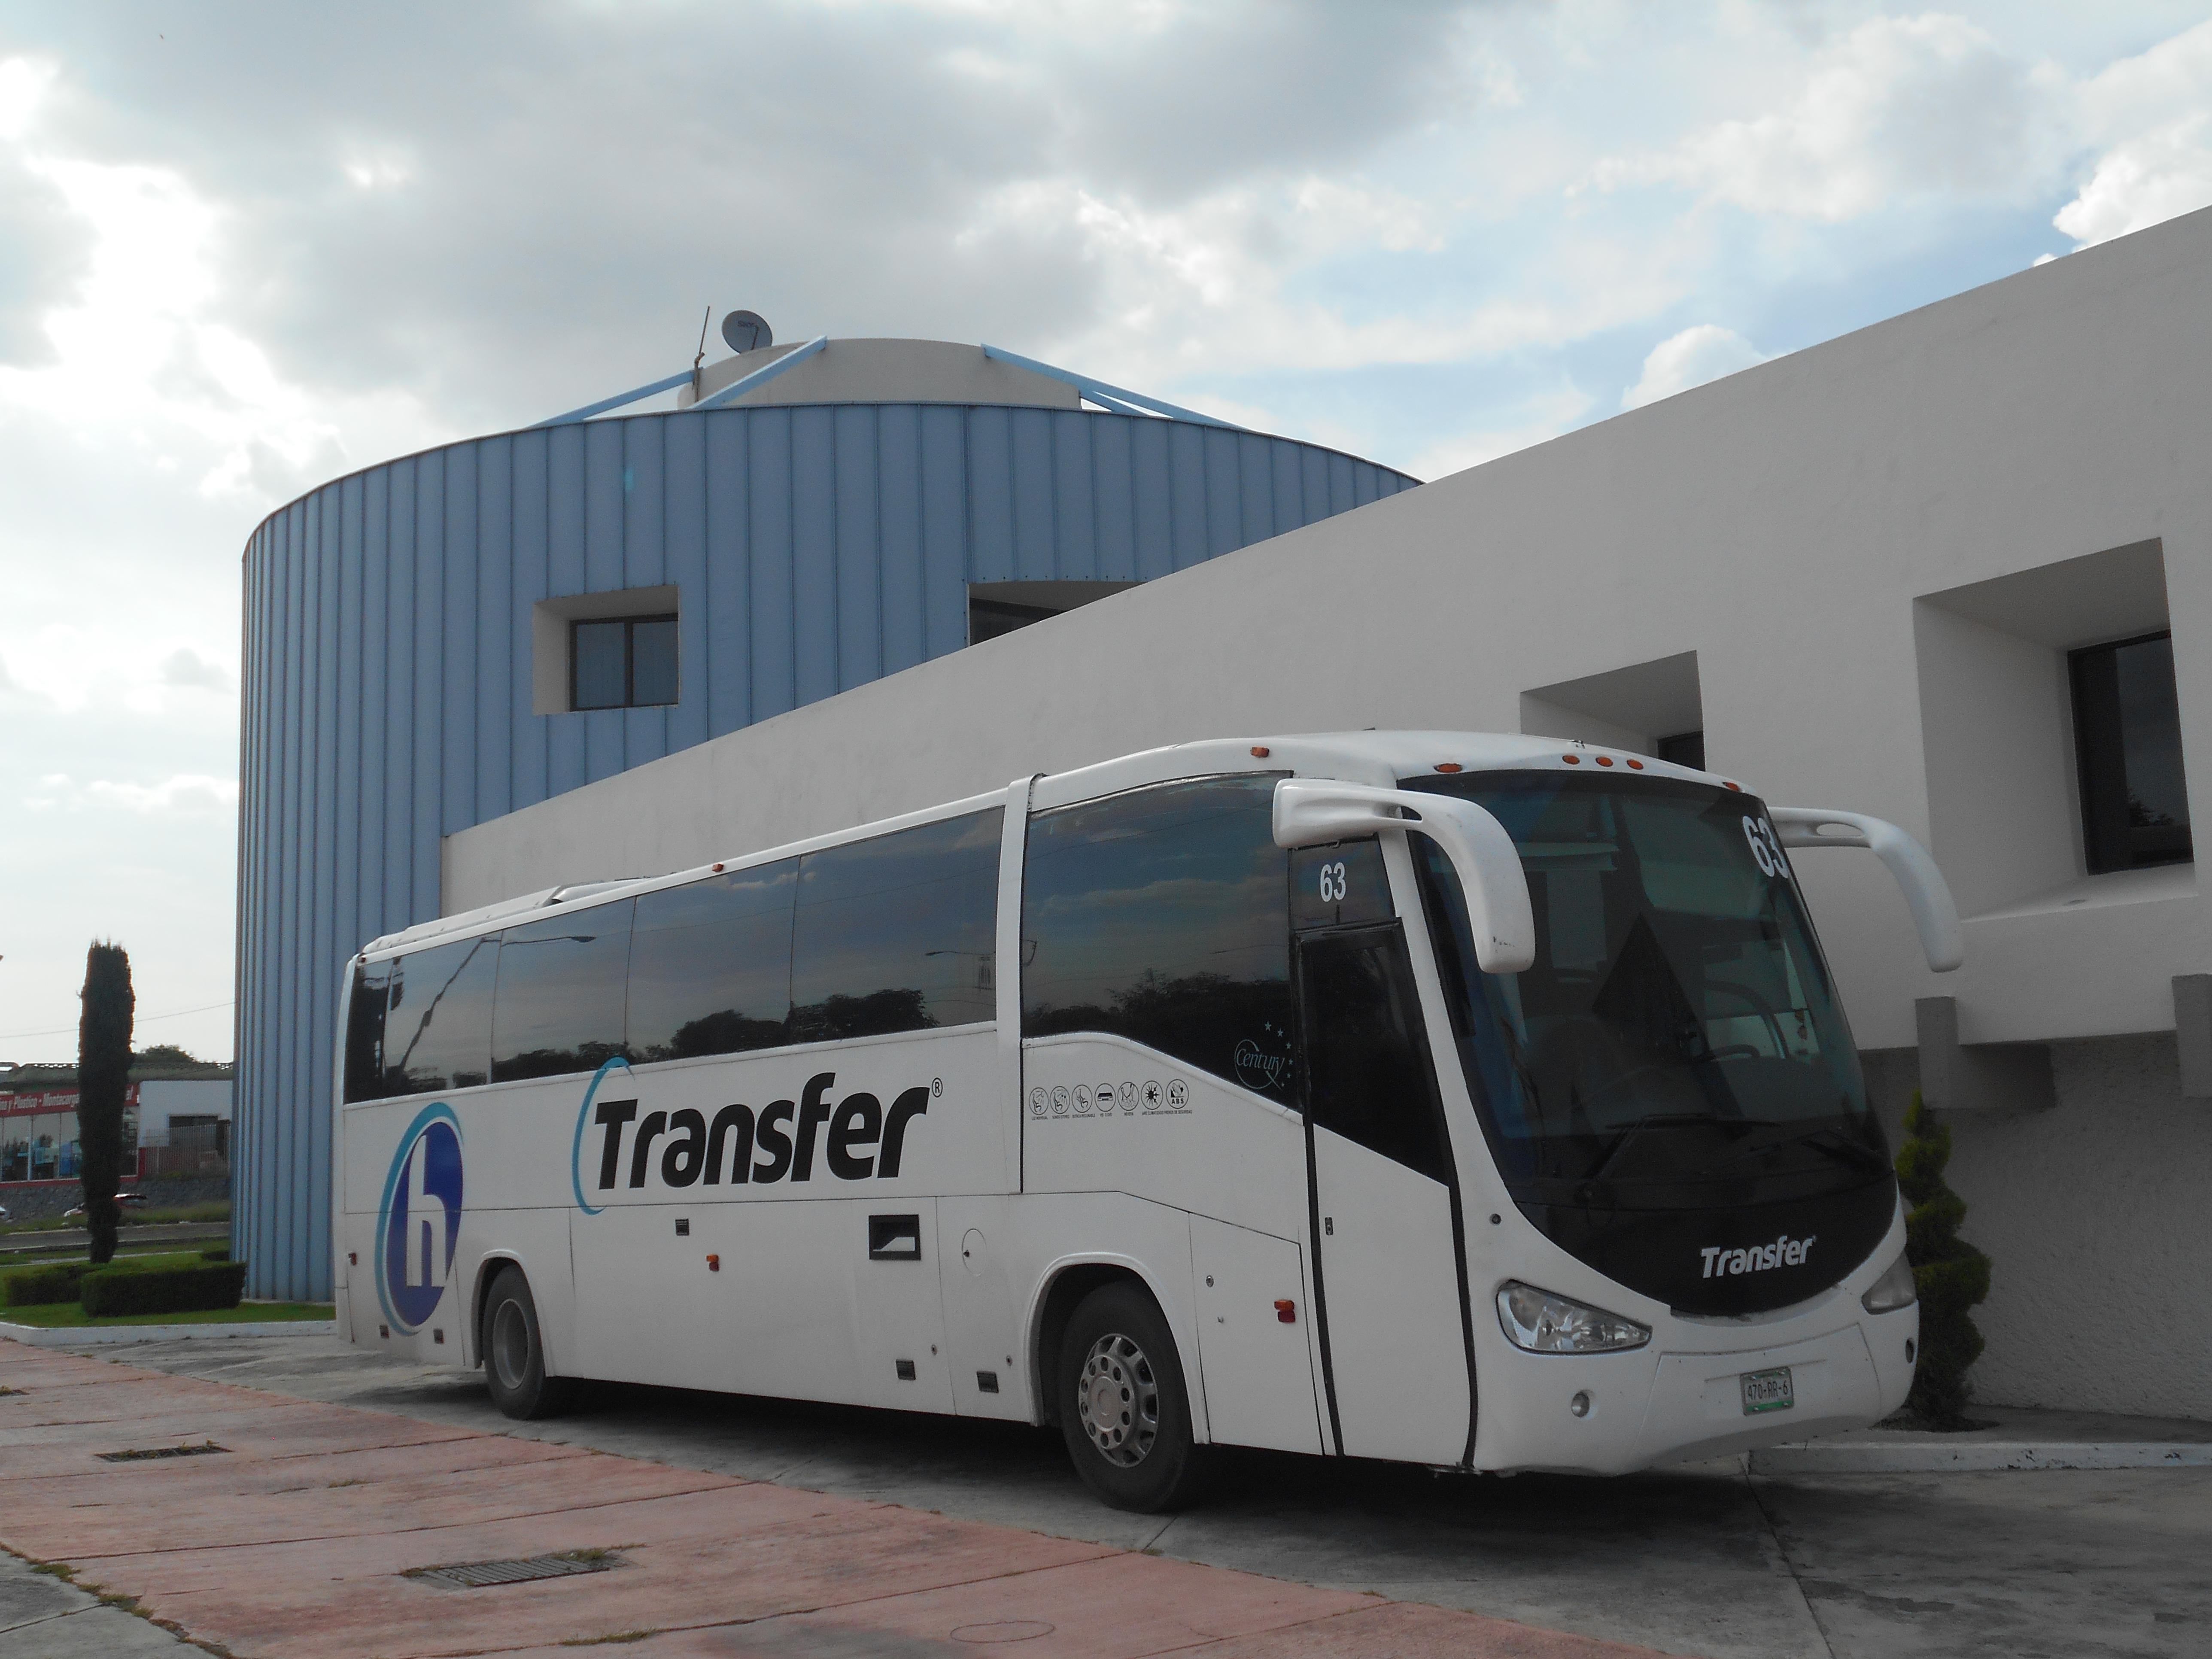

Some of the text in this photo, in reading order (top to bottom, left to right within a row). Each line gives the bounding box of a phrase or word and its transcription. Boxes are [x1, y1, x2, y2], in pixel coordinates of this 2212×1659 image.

[1743, 816, 1788, 878] 63
[1320, 862, 1346, 902] 63
[1237, 1049, 1285, 1076] Century
[43, 1093, 79, 1108] Montacarga
[595, 1072, 930, 1189] Transfer
[1701, 1235, 1813, 1279] Transfer
